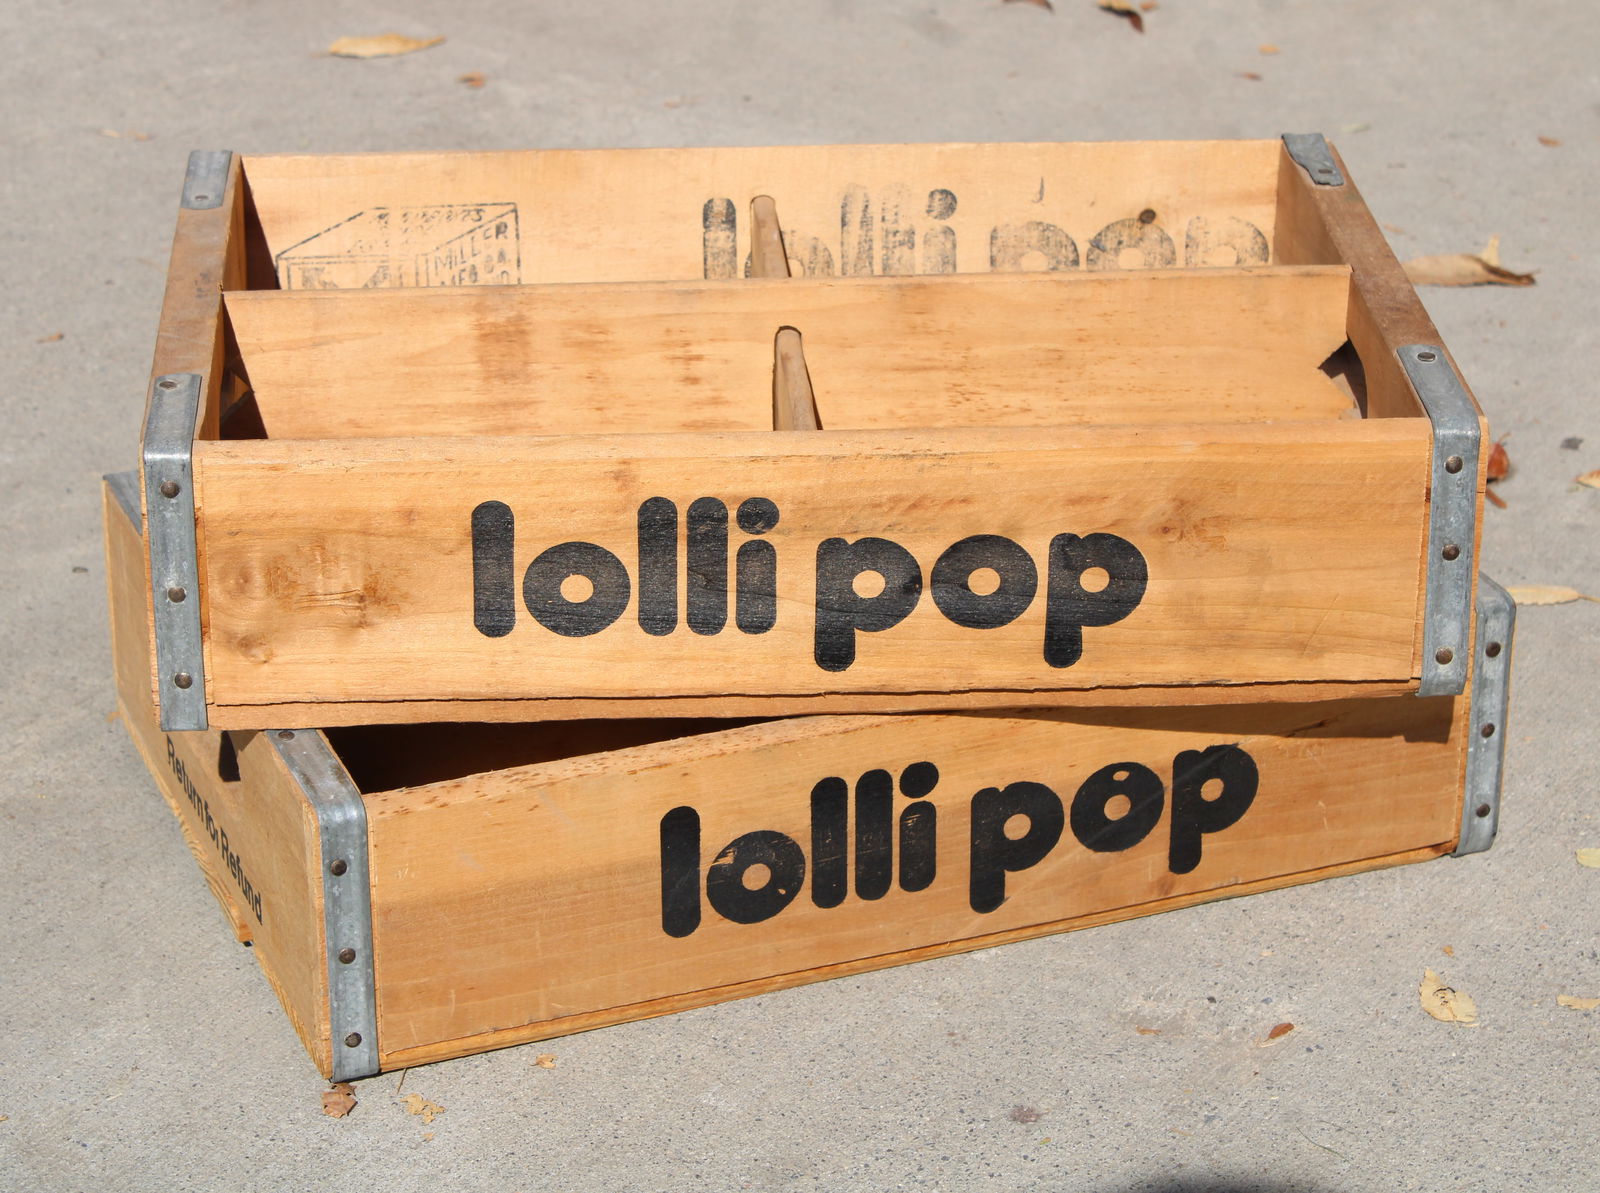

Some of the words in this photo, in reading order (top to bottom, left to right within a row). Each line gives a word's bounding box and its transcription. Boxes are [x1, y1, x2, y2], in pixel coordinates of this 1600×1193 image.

[471, 496, 779, 638] lolli
[813, 532, 1149, 673] pop
[166, 733, 205, 823] Return
[203, 800, 219, 851] for
[219, 826, 264, 927] Refund
[659, 761, 940, 939] lolli
[969, 742, 1260, 914] pop
